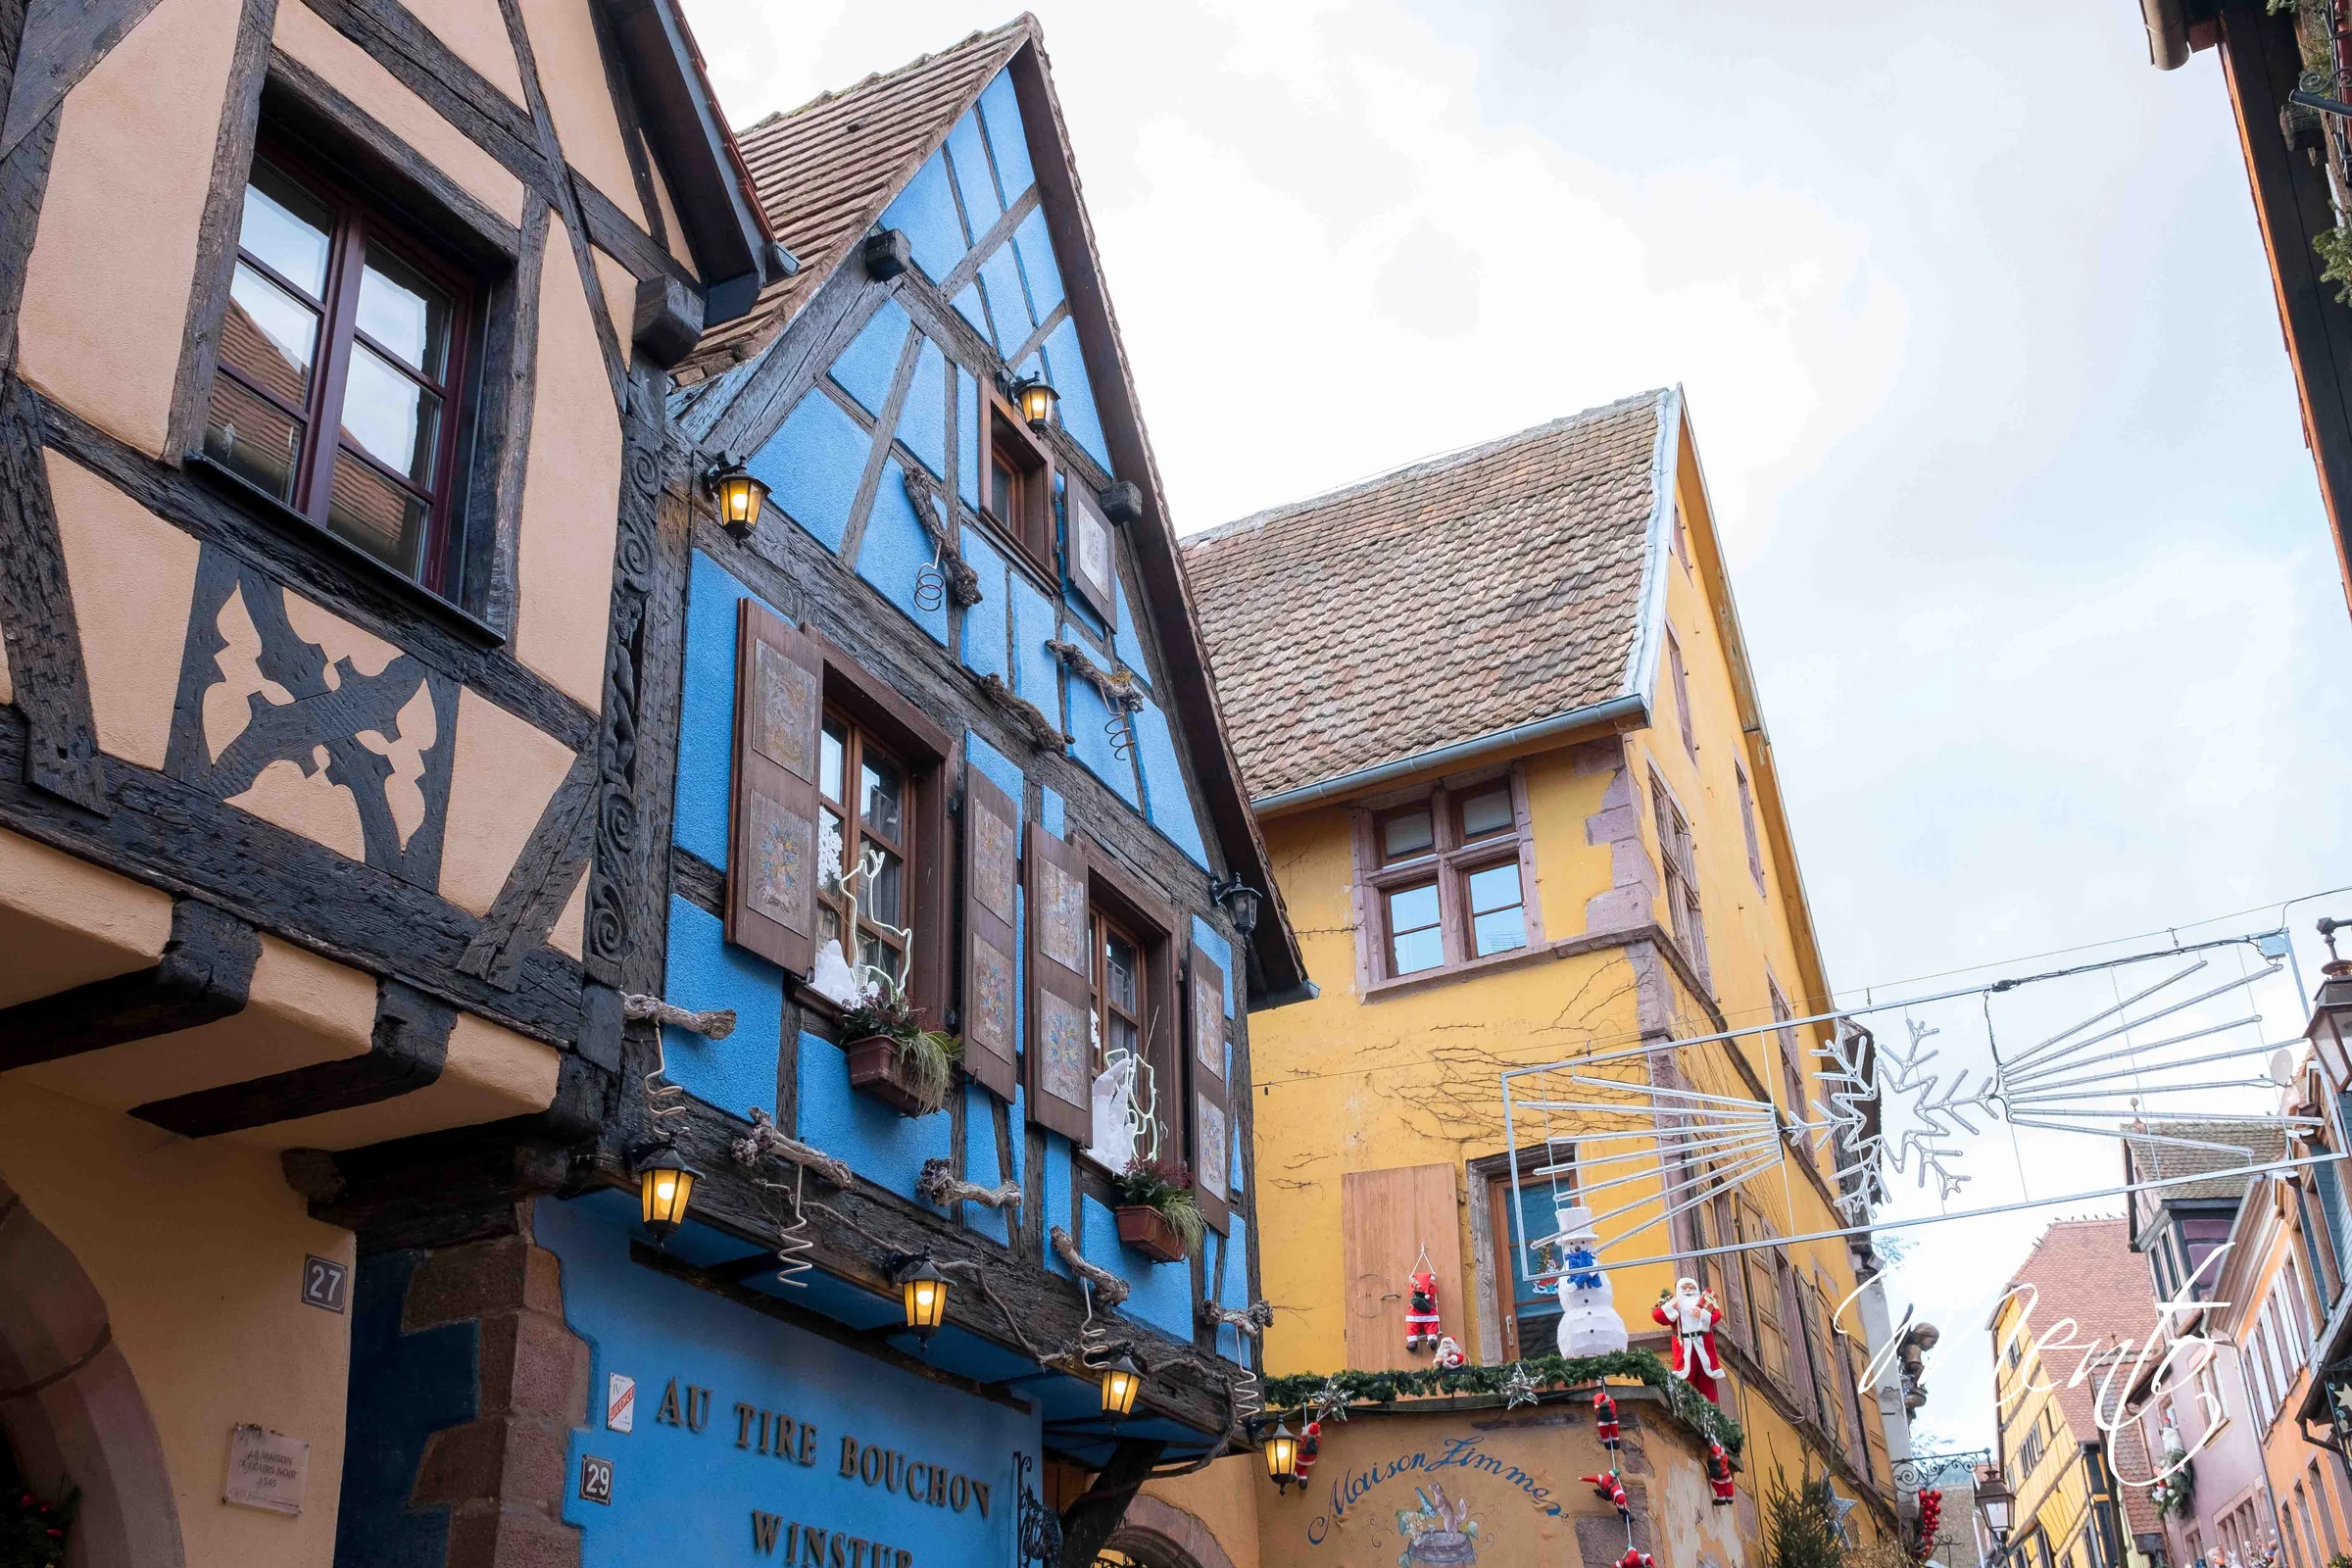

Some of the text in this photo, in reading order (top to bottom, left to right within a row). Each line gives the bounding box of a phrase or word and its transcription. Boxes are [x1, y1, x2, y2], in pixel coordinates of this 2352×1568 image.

[310, 1265, 341, 1301] 27
[261, 1451, 293, 1465] MAISON
[658, 1376, 992, 1520] AU TIRE BOUCHON
[586, 1463, 610, 1496] 29
[1307, 1435, 1568, 1545] Maison Zimmer
